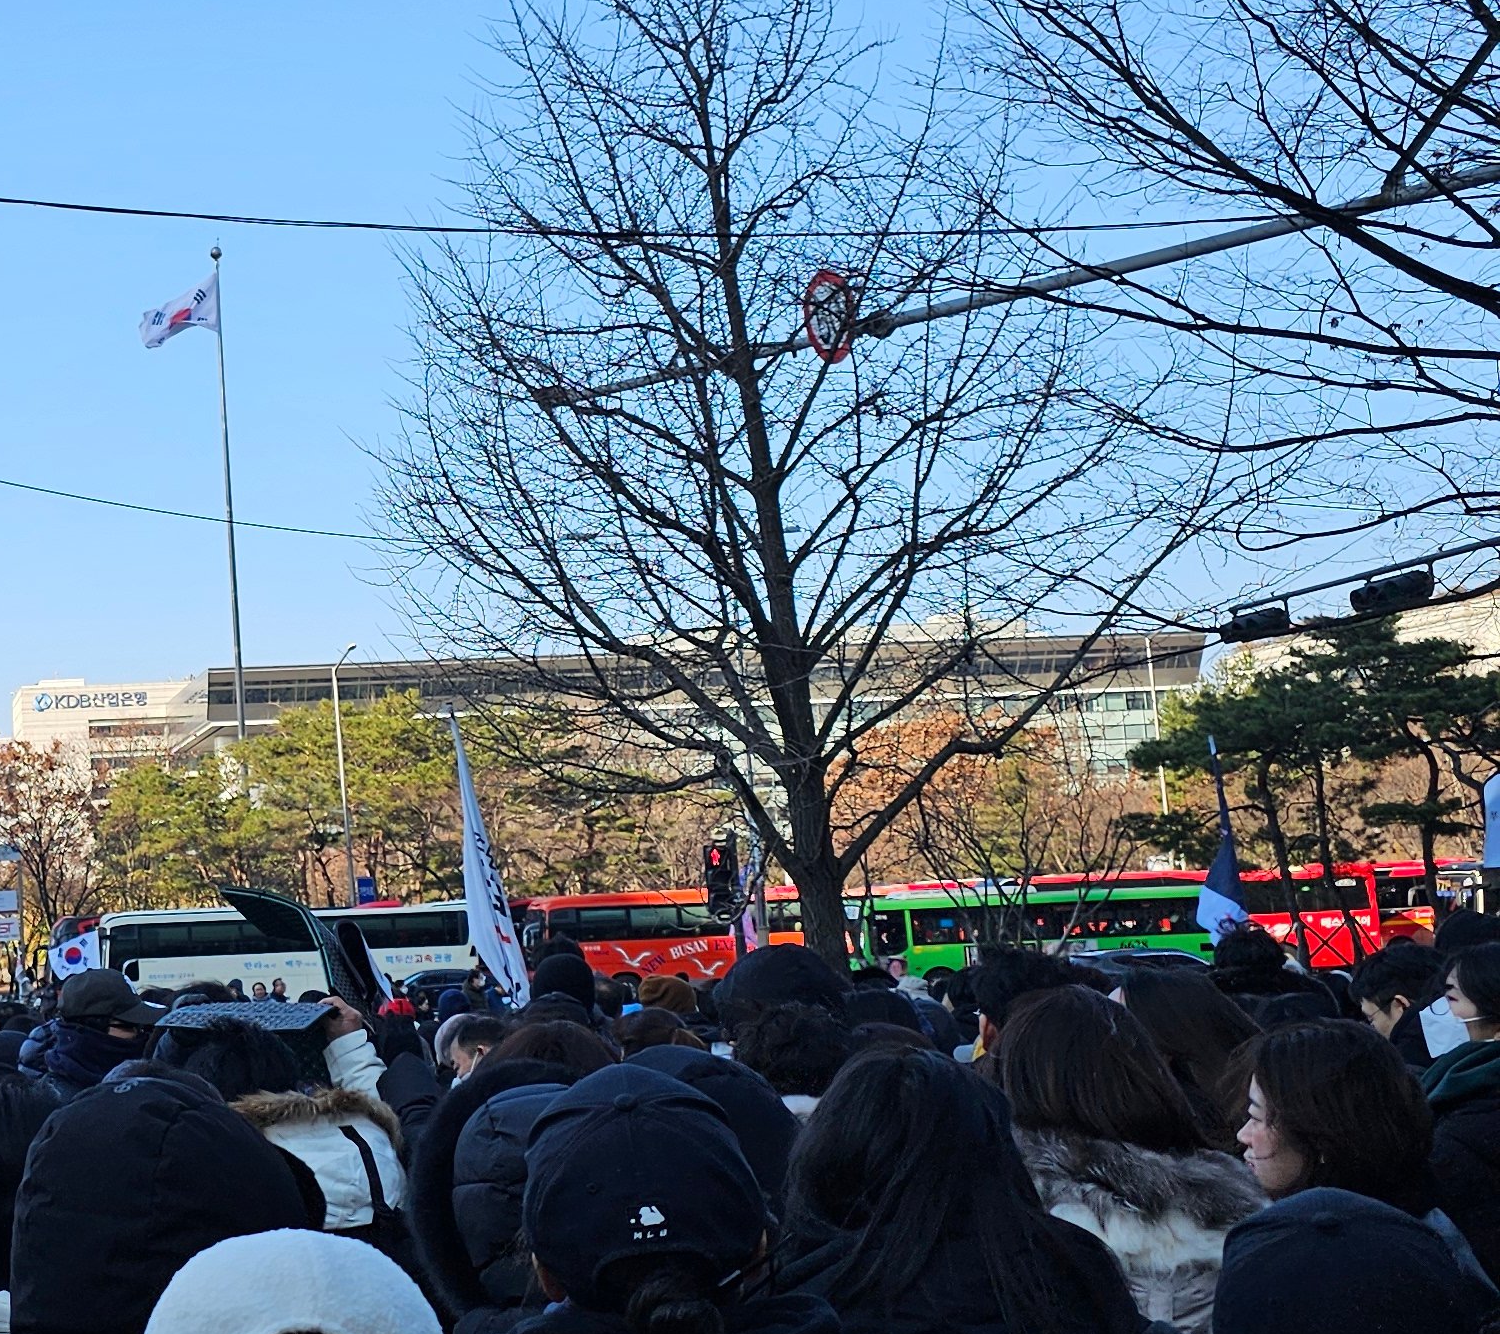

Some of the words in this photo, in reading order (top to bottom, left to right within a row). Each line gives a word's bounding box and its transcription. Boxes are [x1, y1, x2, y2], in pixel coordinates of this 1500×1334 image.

[54, 691, 148, 710] KDB산업은행
[668, 939, 709, 960] BUSAN
[642, 953, 668, 975] NEW
